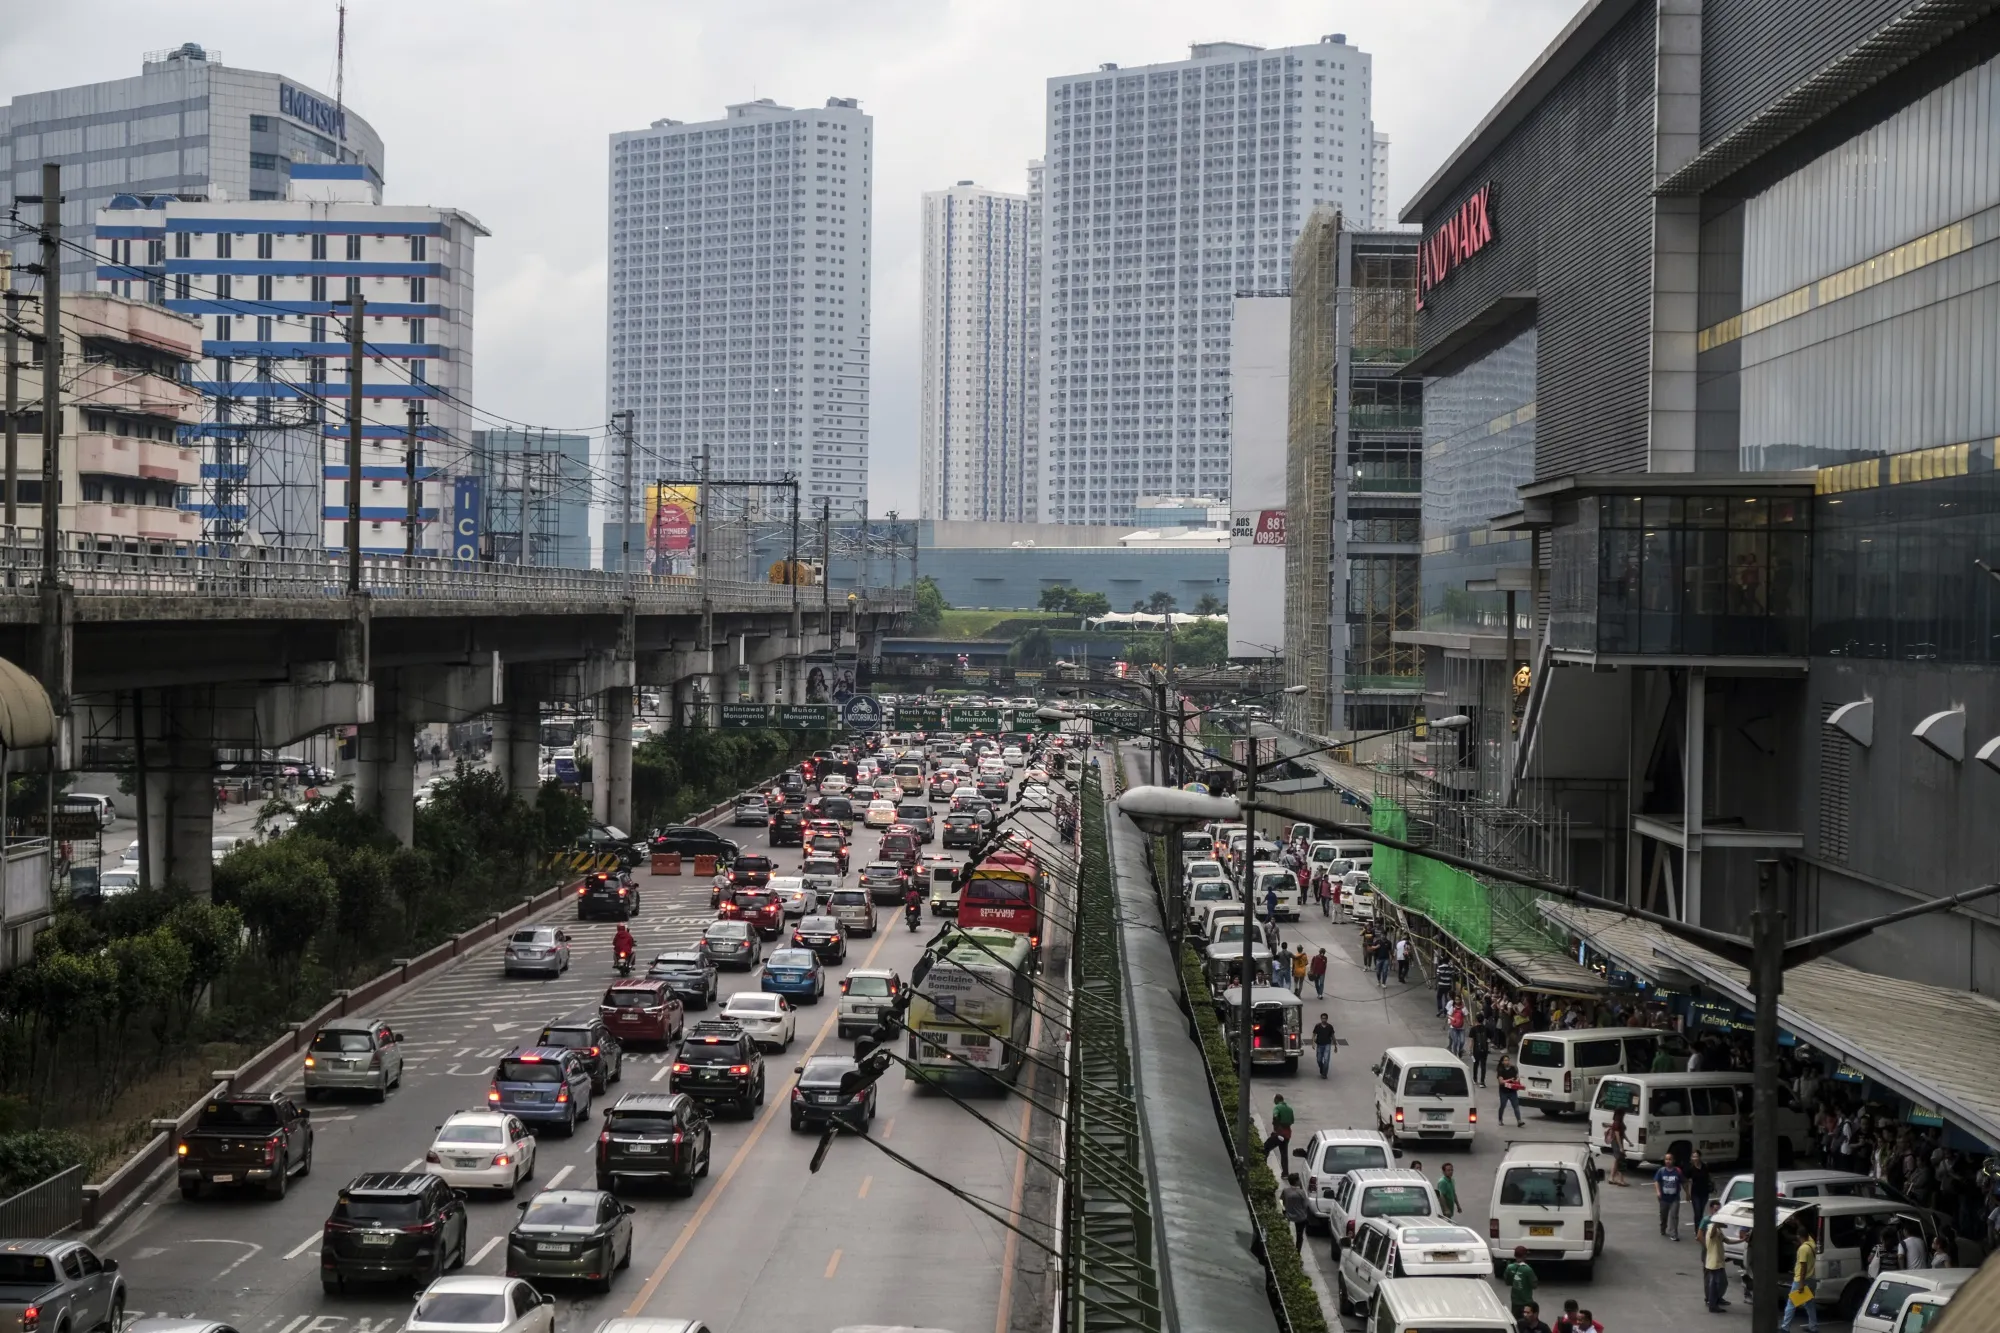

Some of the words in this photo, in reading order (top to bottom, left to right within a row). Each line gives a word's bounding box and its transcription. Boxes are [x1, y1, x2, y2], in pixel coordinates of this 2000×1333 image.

[1416, 180, 1491, 312] LANDMARK
[1236, 518, 1250, 526] ADS
[1232, 528, 1254, 537] SPACE
[847, 713, 878, 722] MOTORSIKLO
[928, 974, 974, 983] Meclizine
[928, 982, 972, 991] Bonamine
